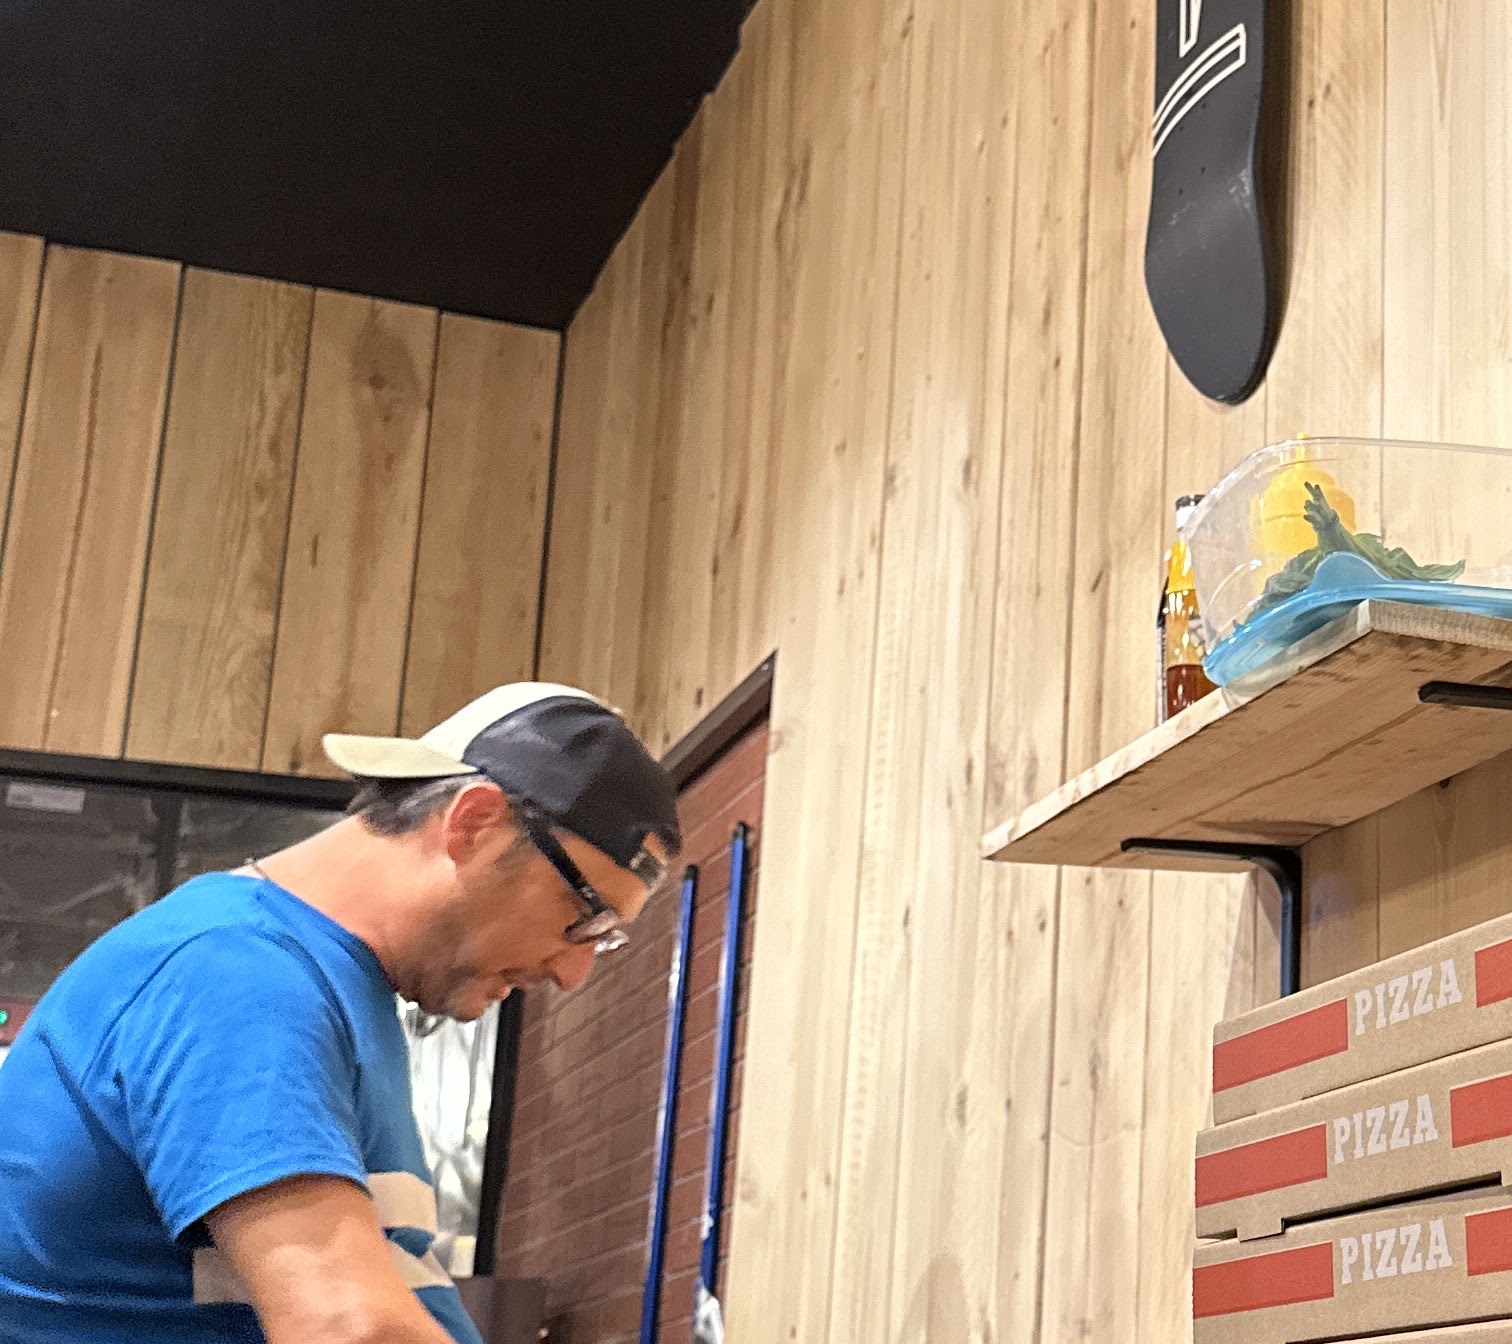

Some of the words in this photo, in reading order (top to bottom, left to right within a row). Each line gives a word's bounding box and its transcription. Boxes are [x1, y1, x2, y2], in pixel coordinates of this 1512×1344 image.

[1355, 960, 1462, 1036] PIZZA
[1333, 1093, 1438, 1164] PIZZA
[1339, 1218, 1453, 1286] PIZZA
